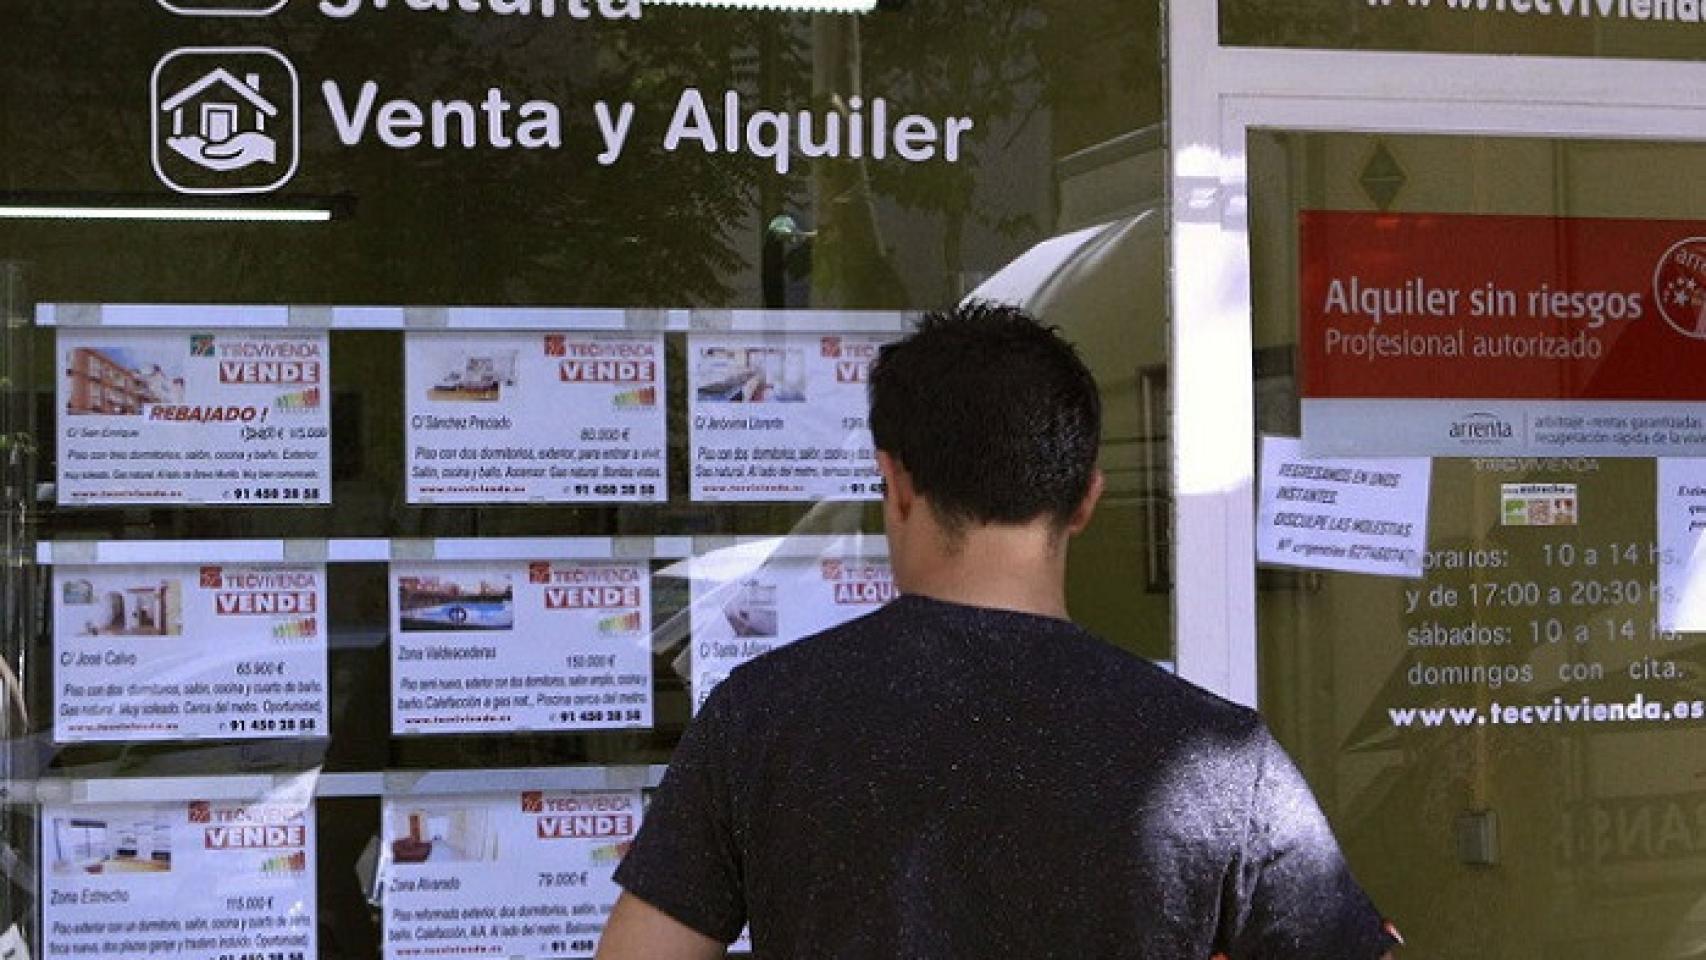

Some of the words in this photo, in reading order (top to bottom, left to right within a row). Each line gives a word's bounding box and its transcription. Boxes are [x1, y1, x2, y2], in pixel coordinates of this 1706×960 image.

[321, 79, 562, 149] Venta
[593, 100, 635, 165] y
[663, 88, 973, 174] Alquiler
[1324, 276, 1460, 322] Alquiler
[1470, 283, 1516, 318] sin
[1527, 283, 1642, 328] riesgos
[1324, 328, 1464, 361] Profesional
[1473, 332, 1601, 360] autorizado
[220, 362, 320, 383] VENDE
[562, 361, 655, 382] VENDE
[149, 405, 257, 422] REBAJADO
[427, 414, 467, 429] Sánchez
[469, 414, 512, 429] Preciado
[1449, 421, 1513, 439] arrenta
[233, 488, 249, 499] 91
[575, 485, 589, 495] 91
[1543, 543, 1575, 566] 10
[1584, 550, 1597, 564] a
[1610, 543, 1638, 564] 14
[547, 587, 640, 608] VENDE
[836, 583, 893, 602] ALQU
[1405, 590, 1422, 614] y
[1429, 585, 1458, 608] de
[1469, 583, 1540, 608] 17:00
[1547, 588, 1561, 604] a
[1571, 580, 1641, 604] 20:30
[218, 593, 315, 614] VENDE
[1407, 622, 1512, 647] sábados:
[1530, 621, 1564, 643] 10
[1575, 626, 1589, 642] a
[1607, 620, 1635, 642] 14
[105, 650, 137, 666] Calvo
[398, 646, 422, 661] Zona
[1408, 662, 1533, 688] domingos
[1559, 661, 1604, 683] con
[1629, 656, 1684, 681] cita.
[560, 712, 576, 722] 91
[1389, 693, 1705, 727] www.tecvivienda.es
[230, 720, 245, 732] 91
[206, 826, 305, 848] VENDE
[538, 816, 632, 838] VENDE
[418, 876, 460, 890] Alvarado
[538, 873, 577, 887] 79.000
[51, 890, 77, 905] Zona
[81, 889, 129, 904] Estrecho
